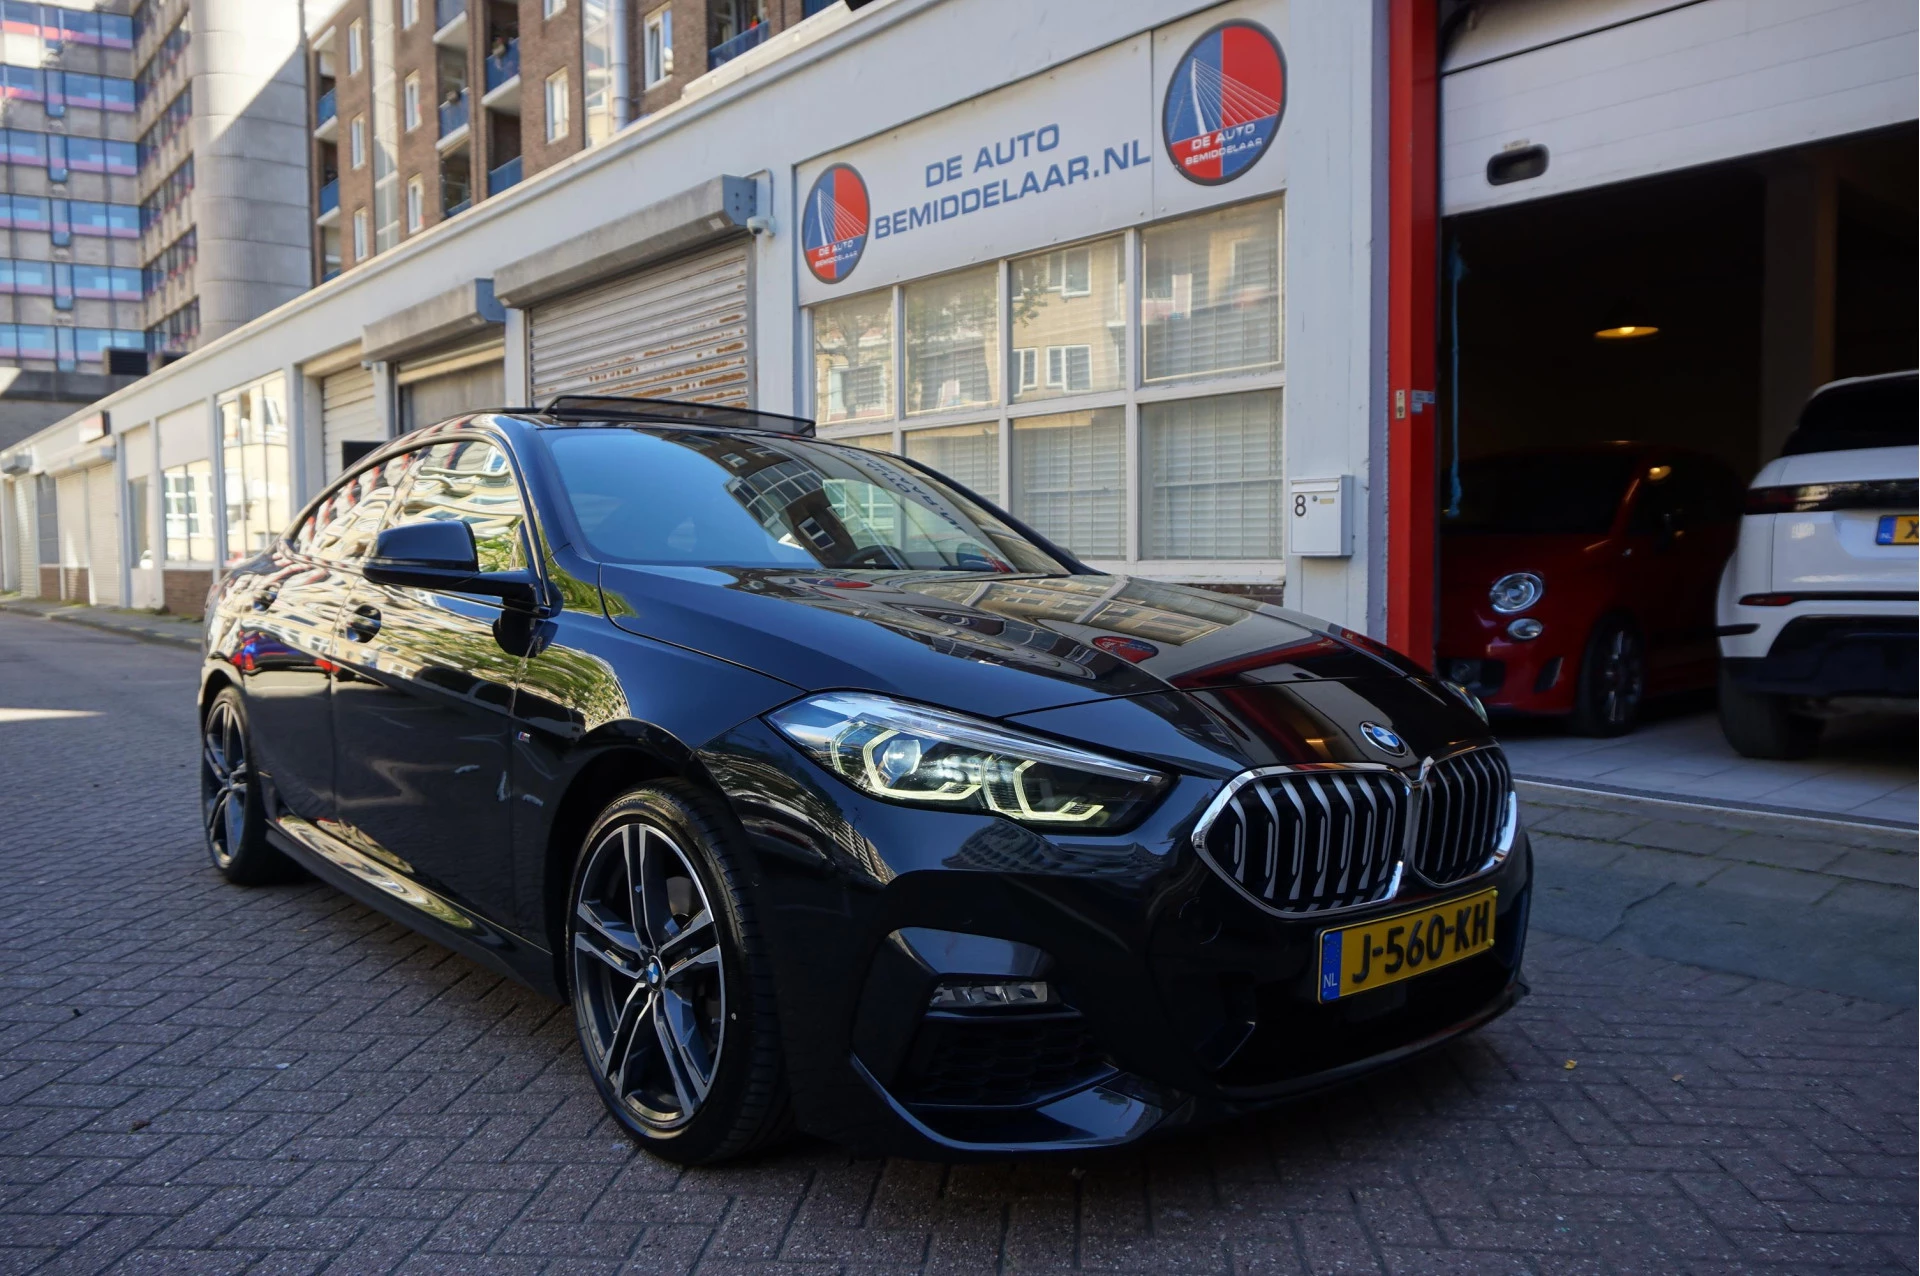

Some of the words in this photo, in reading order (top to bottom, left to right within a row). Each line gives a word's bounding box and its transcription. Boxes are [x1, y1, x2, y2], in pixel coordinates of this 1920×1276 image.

[1184, 137, 1263, 165] BEMIDDELAAR
[1192, 136, 1211, 151] DE
[1215, 123, 1256, 145] AUTO
[925, 154, 963, 188] DE
[973, 123, 1060, 174] AUTO
[874, 139, 1152, 240] BEMIDDELAAR.NL
[818, 246, 830, 256] DE
[832, 239, 854, 253] AUTO
[1294, 494, 1307, 517] 8
[1323, 972, 1338, 989] NL
[1352, 900, 1490, 983] J-560-KH
